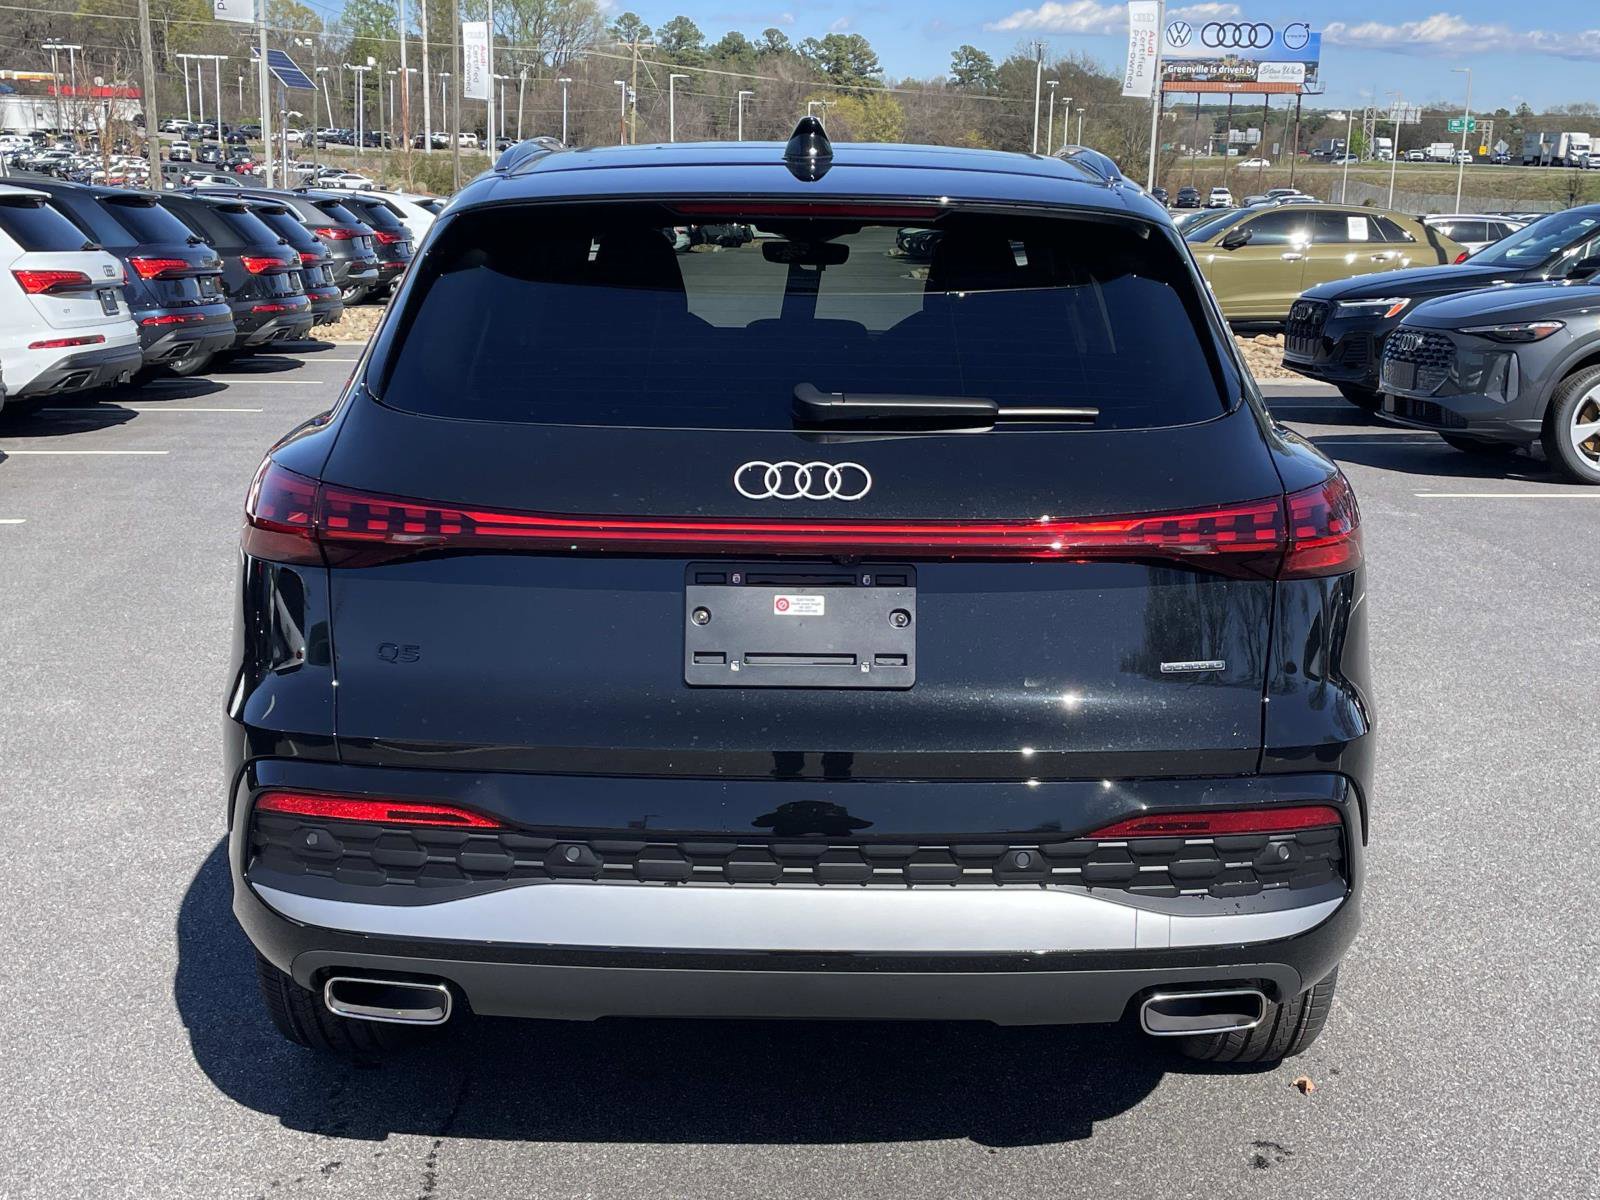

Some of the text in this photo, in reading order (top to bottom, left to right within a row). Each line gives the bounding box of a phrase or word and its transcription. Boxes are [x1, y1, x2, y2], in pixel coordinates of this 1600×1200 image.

[1136, 29, 1148, 77] Certified
[1147, 30, 1156, 56] Audi
[1125, 29, 1140, 89] Pre-owned
[1167, 64, 1208, 73] Greenville
[1210, 64, 1217, 73] is
[1218, 64, 1245, 74] driven
[1247, 65, 1257, 75] by
[377, 642, 420, 664] Q5
